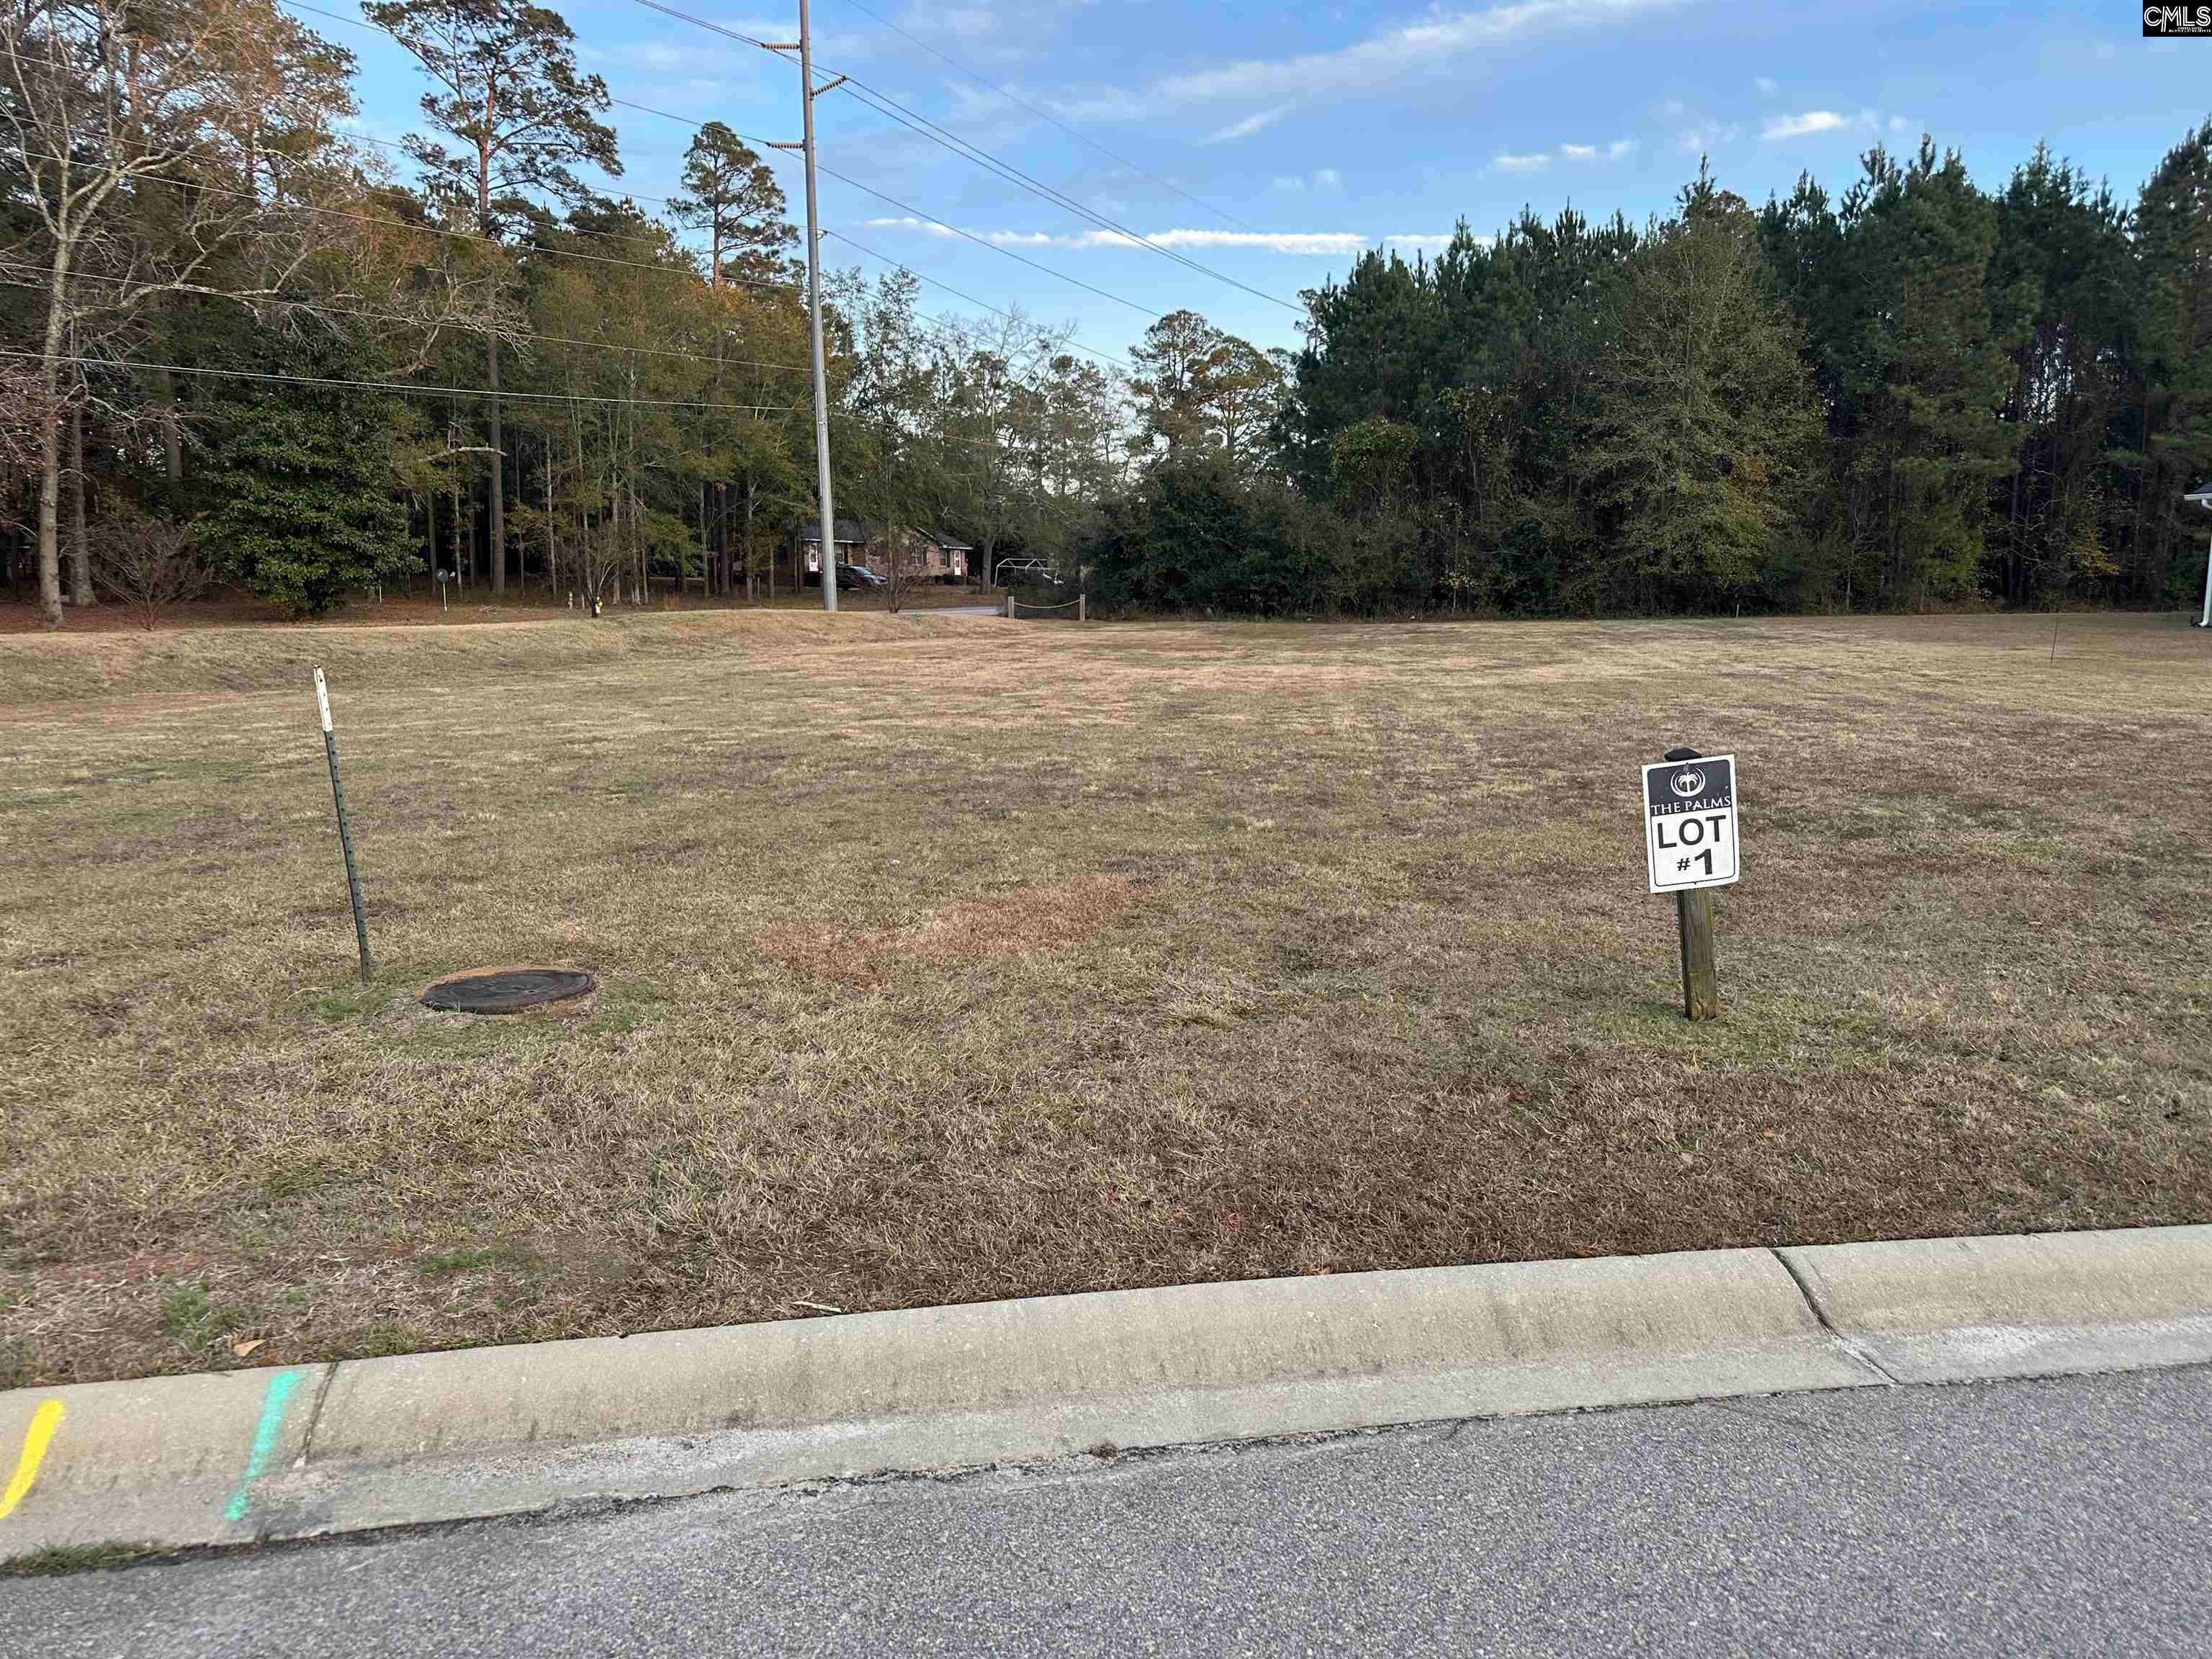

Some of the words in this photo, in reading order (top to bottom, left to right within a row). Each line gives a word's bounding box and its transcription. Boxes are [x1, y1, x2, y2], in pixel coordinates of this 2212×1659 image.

[1650, 801, 1681, 815] THE
[1685, 795, 1731, 811] PALMS
[1658, 814, 1727, 849] LOT
[1676, 848, 1713, 876] #1
